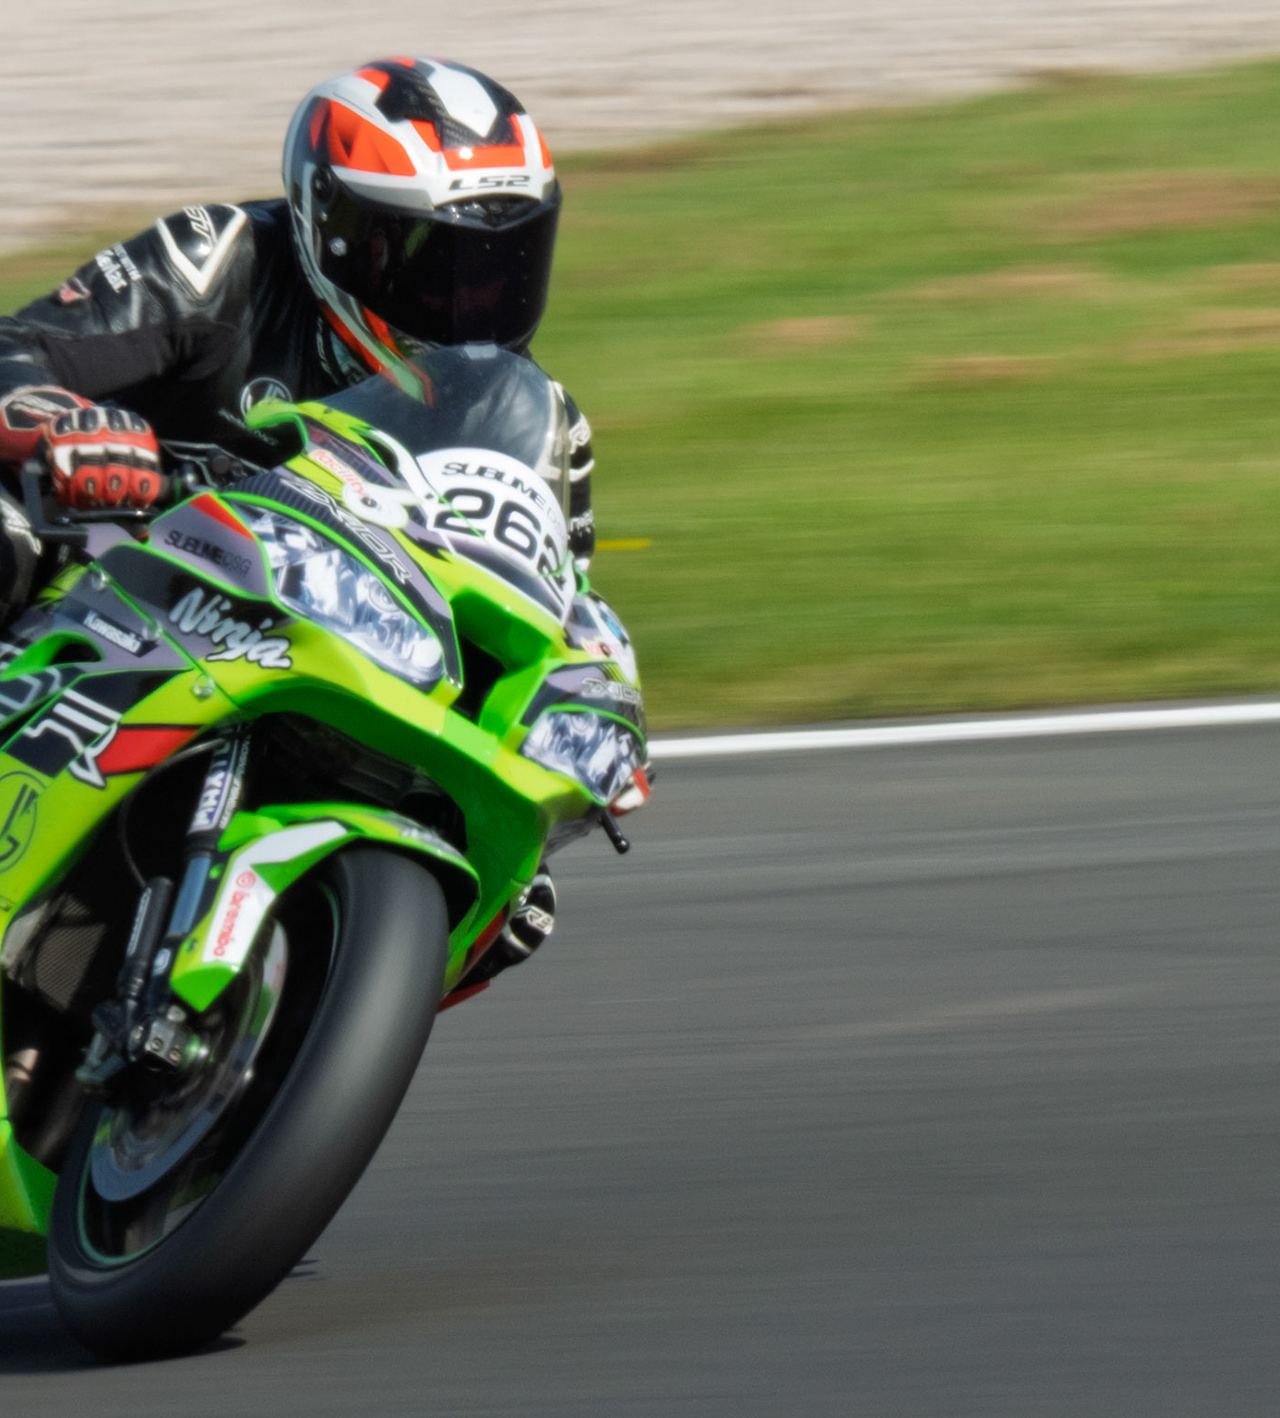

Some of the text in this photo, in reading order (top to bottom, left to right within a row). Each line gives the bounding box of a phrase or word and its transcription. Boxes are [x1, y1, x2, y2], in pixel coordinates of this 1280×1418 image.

[448, 175, 531, 192] LS2
[441, 461, 547, 511] SUBLIME
[82, 609, 145, 655] Kawasaki
[168, 586, 292, 669] Ninja
[213, 888, 251, 957] brembo
